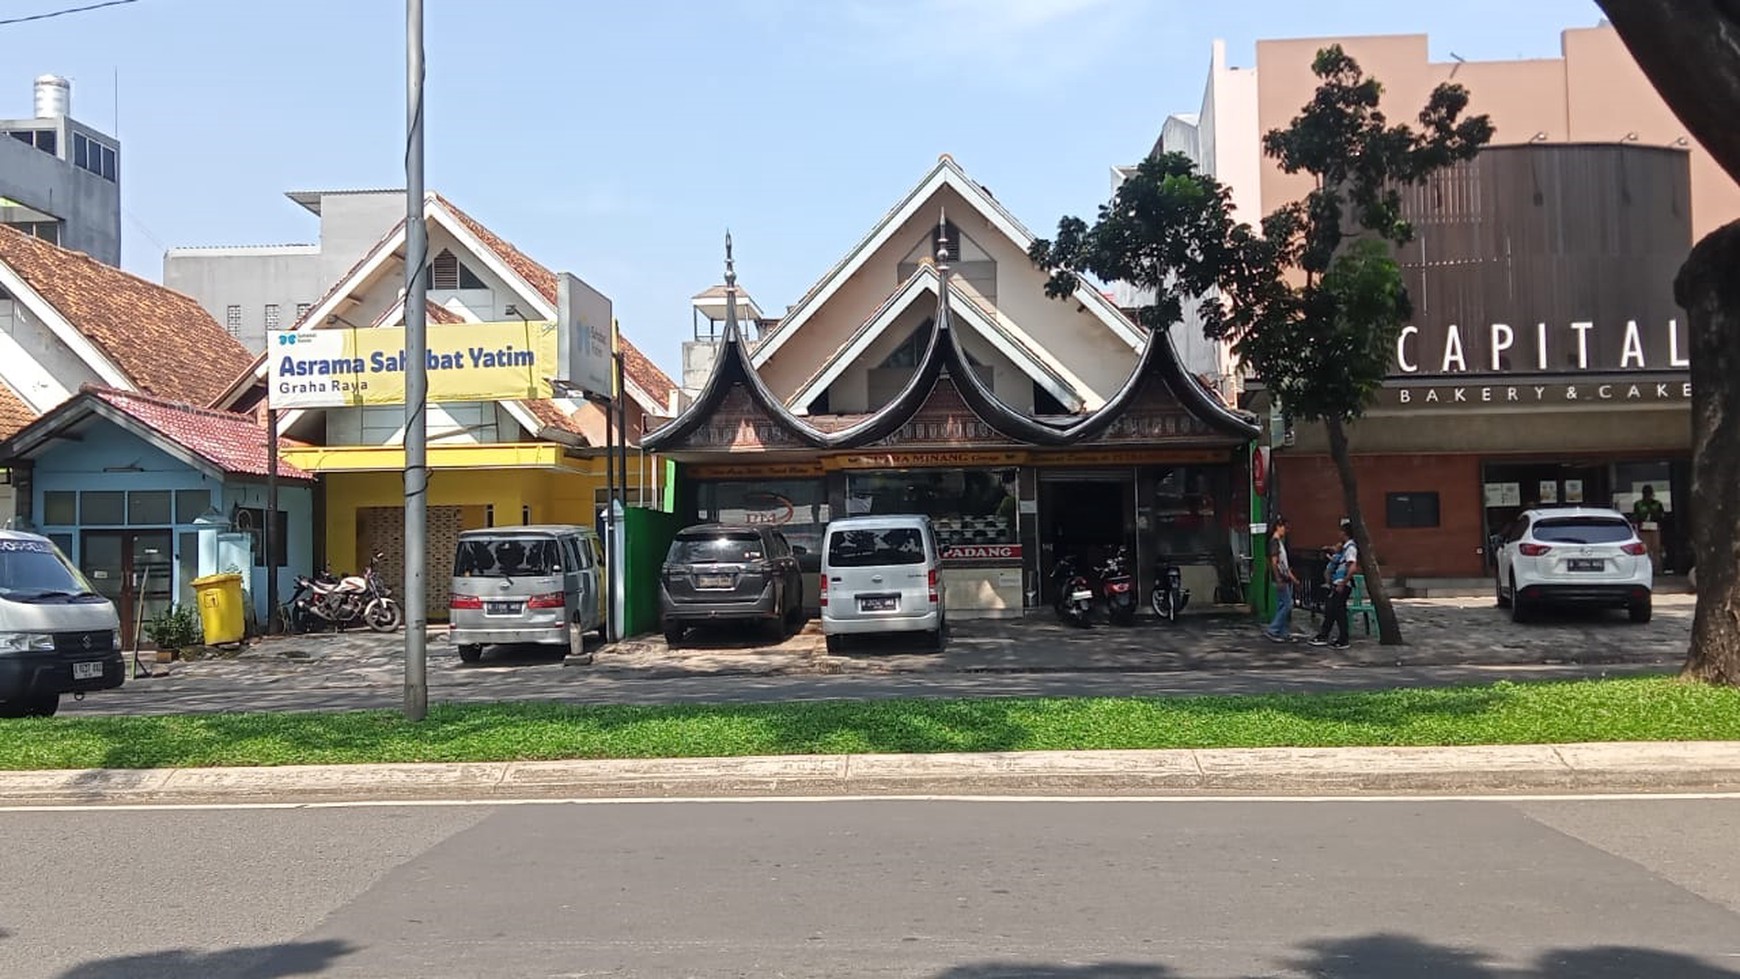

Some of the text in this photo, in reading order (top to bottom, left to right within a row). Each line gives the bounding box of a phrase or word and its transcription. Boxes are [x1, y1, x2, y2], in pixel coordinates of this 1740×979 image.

[1397, 319, 1690, 373] CAPITAL
[279, 345, 534, 377] Asrama Sahbat Yatim
[279, 380, 369, 394] Graha Raya
[1400, 383, 1693, 403] BAKERY & CAKE
